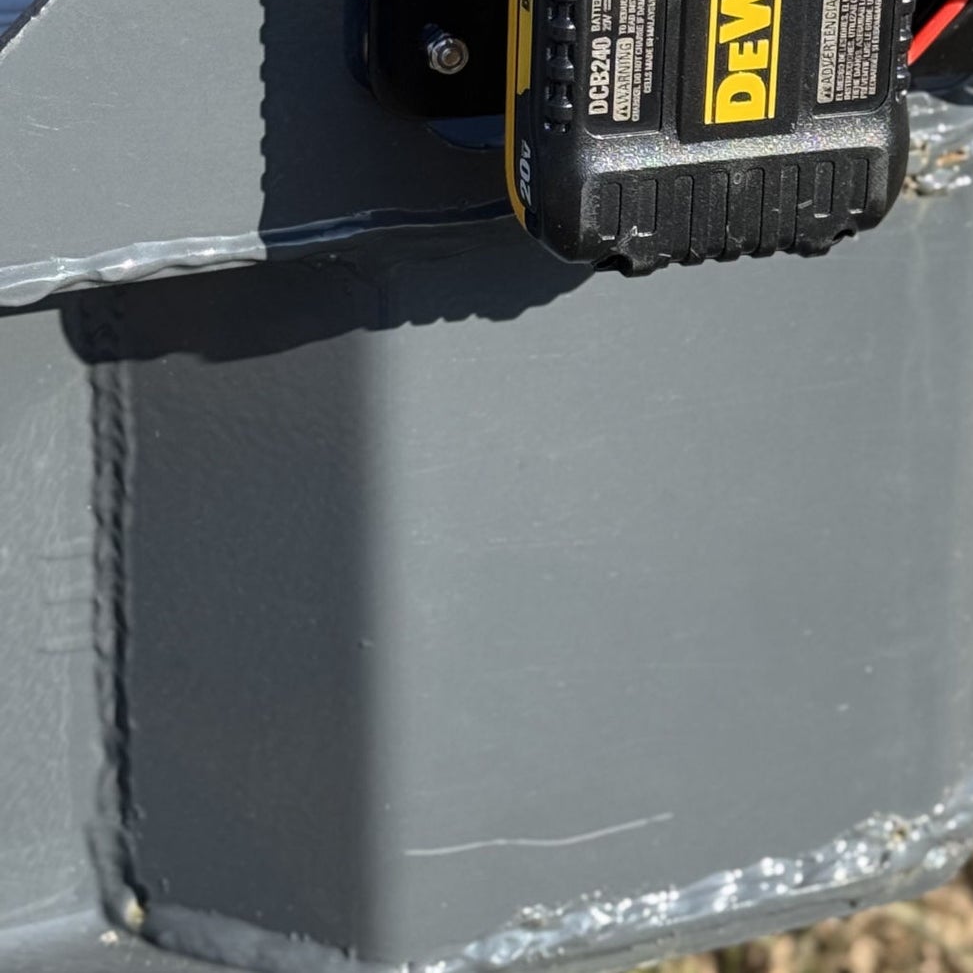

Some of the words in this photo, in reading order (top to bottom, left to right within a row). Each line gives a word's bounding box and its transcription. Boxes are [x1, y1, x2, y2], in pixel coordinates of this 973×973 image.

[602, 14, 612, 32] 20V
[618, 24, 627, 35] TO
[820, 0, 838, 84] ADVERTENCIA
[588, 36, 612, 115] DCB240
[616, 43, 631, 105] WARNING
